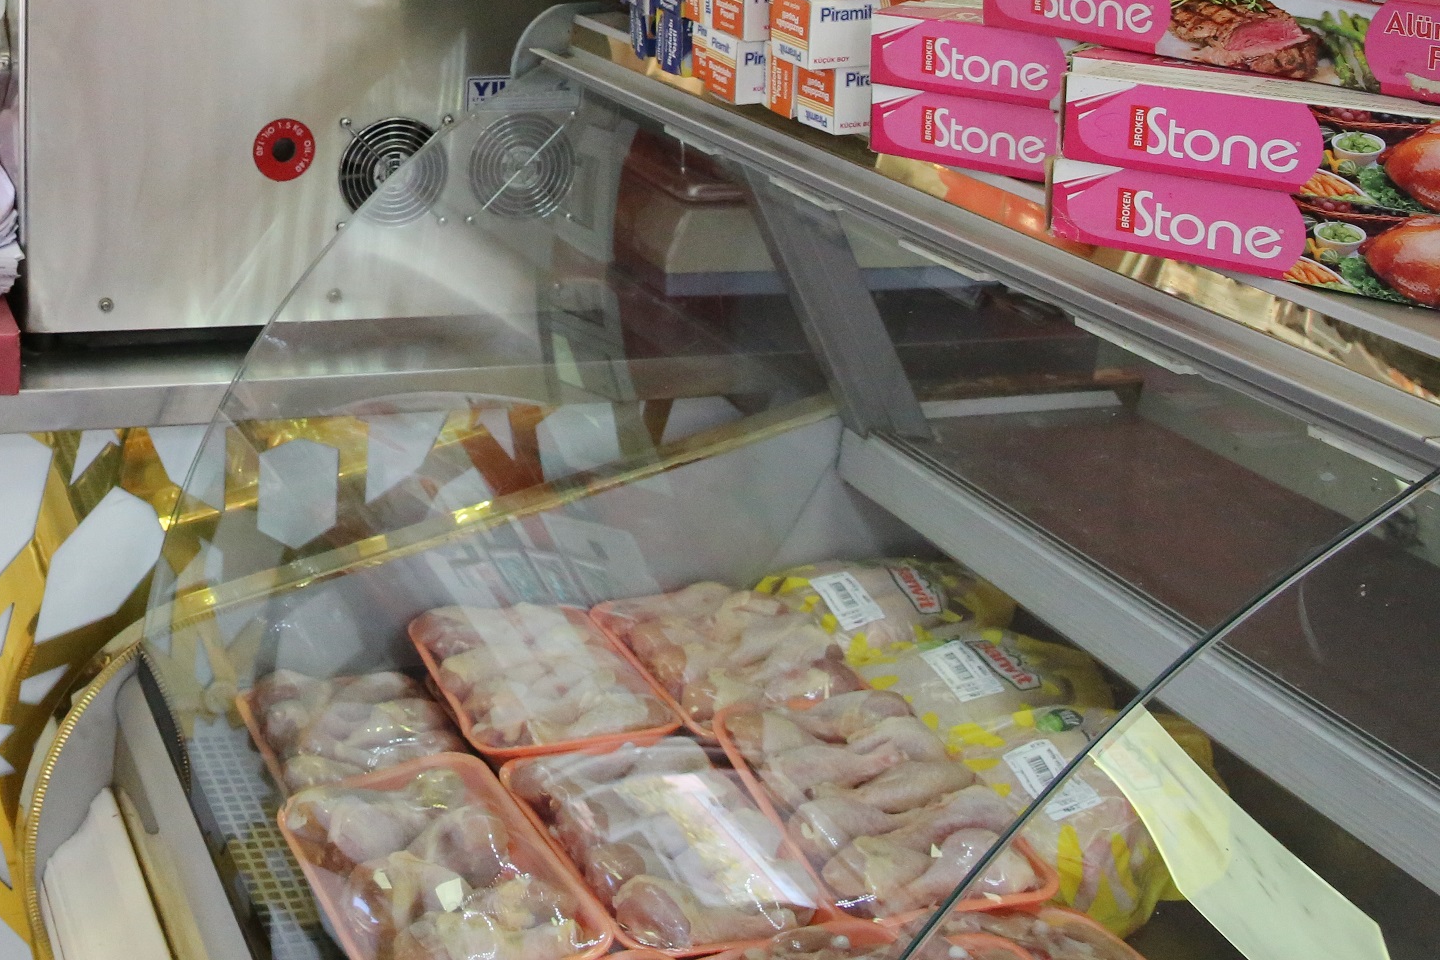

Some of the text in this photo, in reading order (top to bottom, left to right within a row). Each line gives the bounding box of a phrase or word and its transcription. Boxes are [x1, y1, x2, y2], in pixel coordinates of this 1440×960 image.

[836, 55, 850, 63] BOY
[925, 38, 934, 71] BROKEN
[934, 37, 1049, 92] Stone
[925, 107, 1046, 164] BROKEN Stone
[1133, 106, 1299, 173] BROKEN Stone
[1121, 190, 1282, 260] BROKEN Stone
